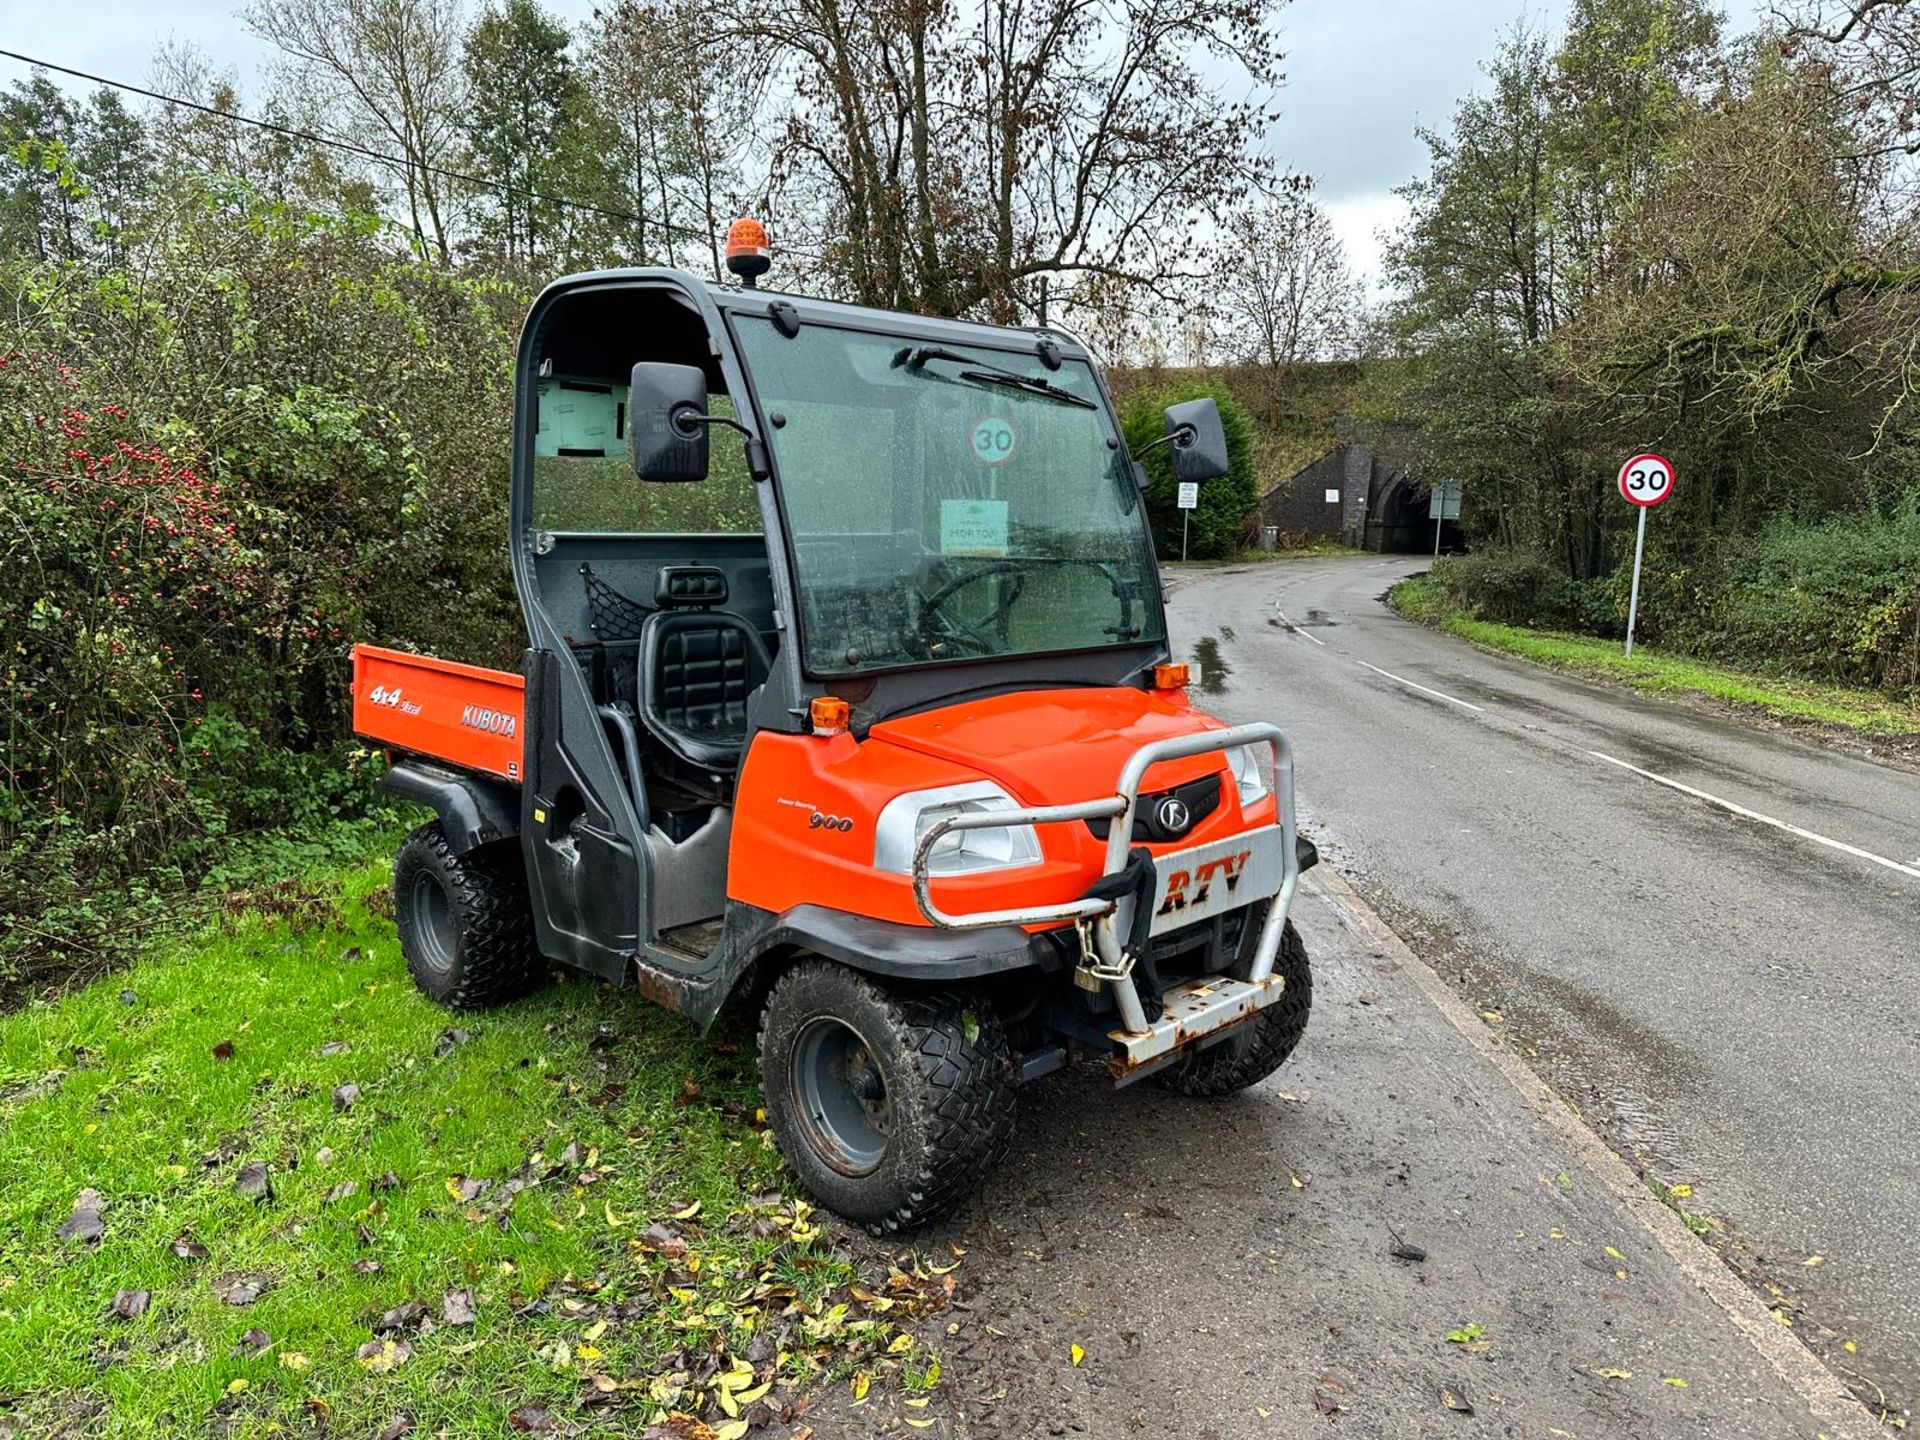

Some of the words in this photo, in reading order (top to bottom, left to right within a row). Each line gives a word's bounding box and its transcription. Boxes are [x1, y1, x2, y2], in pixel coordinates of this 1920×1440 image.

[976, 429, 1012, 451] 30
[1629, 470, 1666, 490] 30
[369, 685, 402, 707] 4x4
[461, 704, 516, 738] KUBOTA
[808, 812, 853, 832] 900
[1156, 850, 1251, 916] RTV
